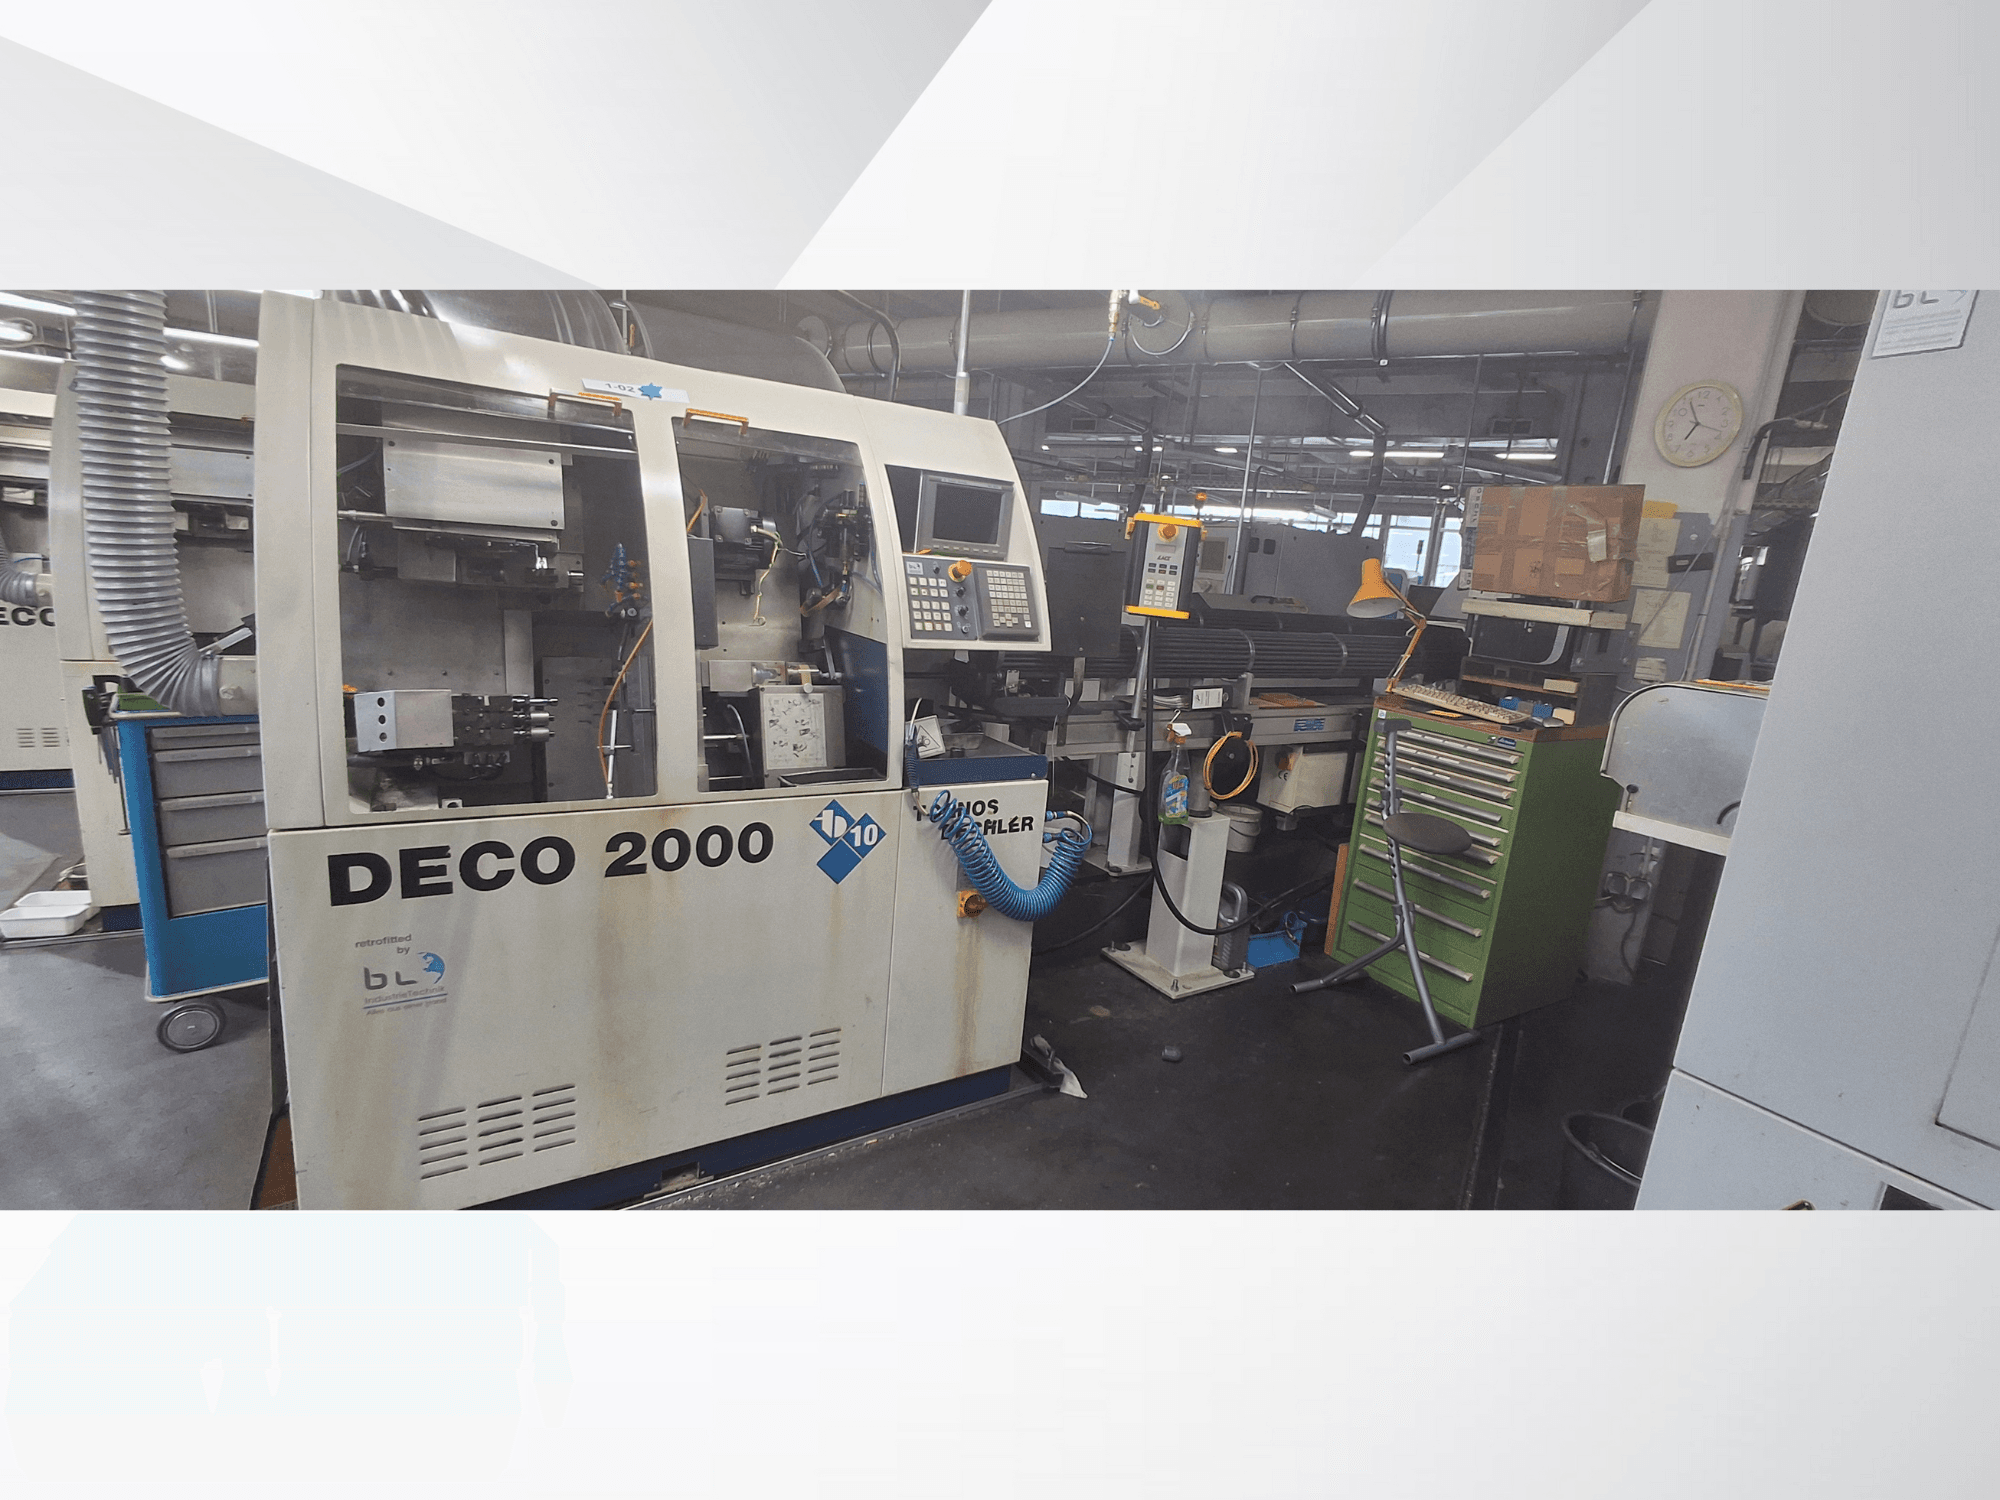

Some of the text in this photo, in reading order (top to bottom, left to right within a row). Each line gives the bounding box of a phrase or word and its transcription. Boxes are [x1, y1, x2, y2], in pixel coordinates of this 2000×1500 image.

[605, 383, 636, 393] 1-02
[913, 799, 999, 822] TNOS
[850, 823, 879, 848] 10
[940, 816, 1034, 841] HLER
[327, 821, 775, 908] DECO 2000
[355, 934, 412, 948] retrofitted
[396, 946, 411, 955] by
